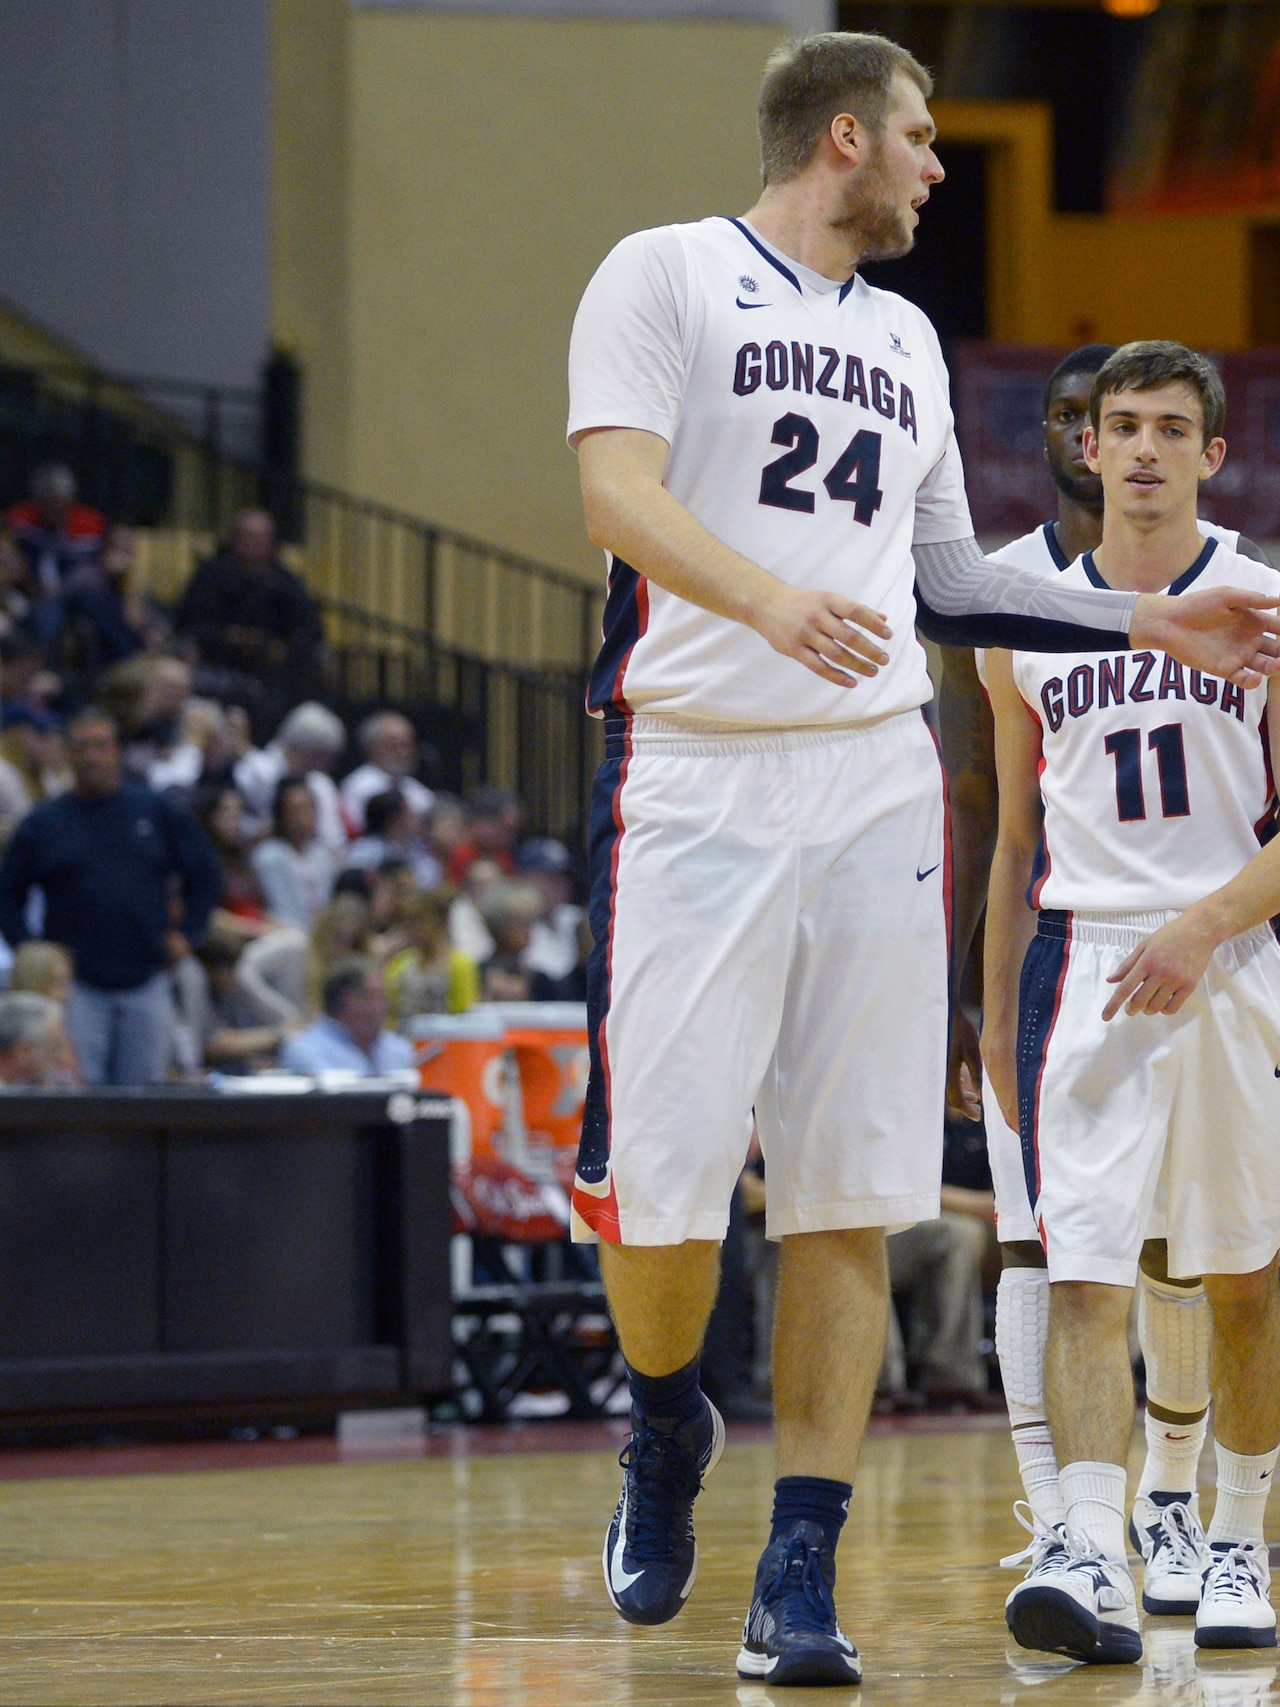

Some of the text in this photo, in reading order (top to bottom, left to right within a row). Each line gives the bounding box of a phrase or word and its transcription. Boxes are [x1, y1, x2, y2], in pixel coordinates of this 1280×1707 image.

[732, 340, 917, 446] GONZAGA
[758, 411, 883, 527] 24
[1104, 722, 1191, 822] 11
